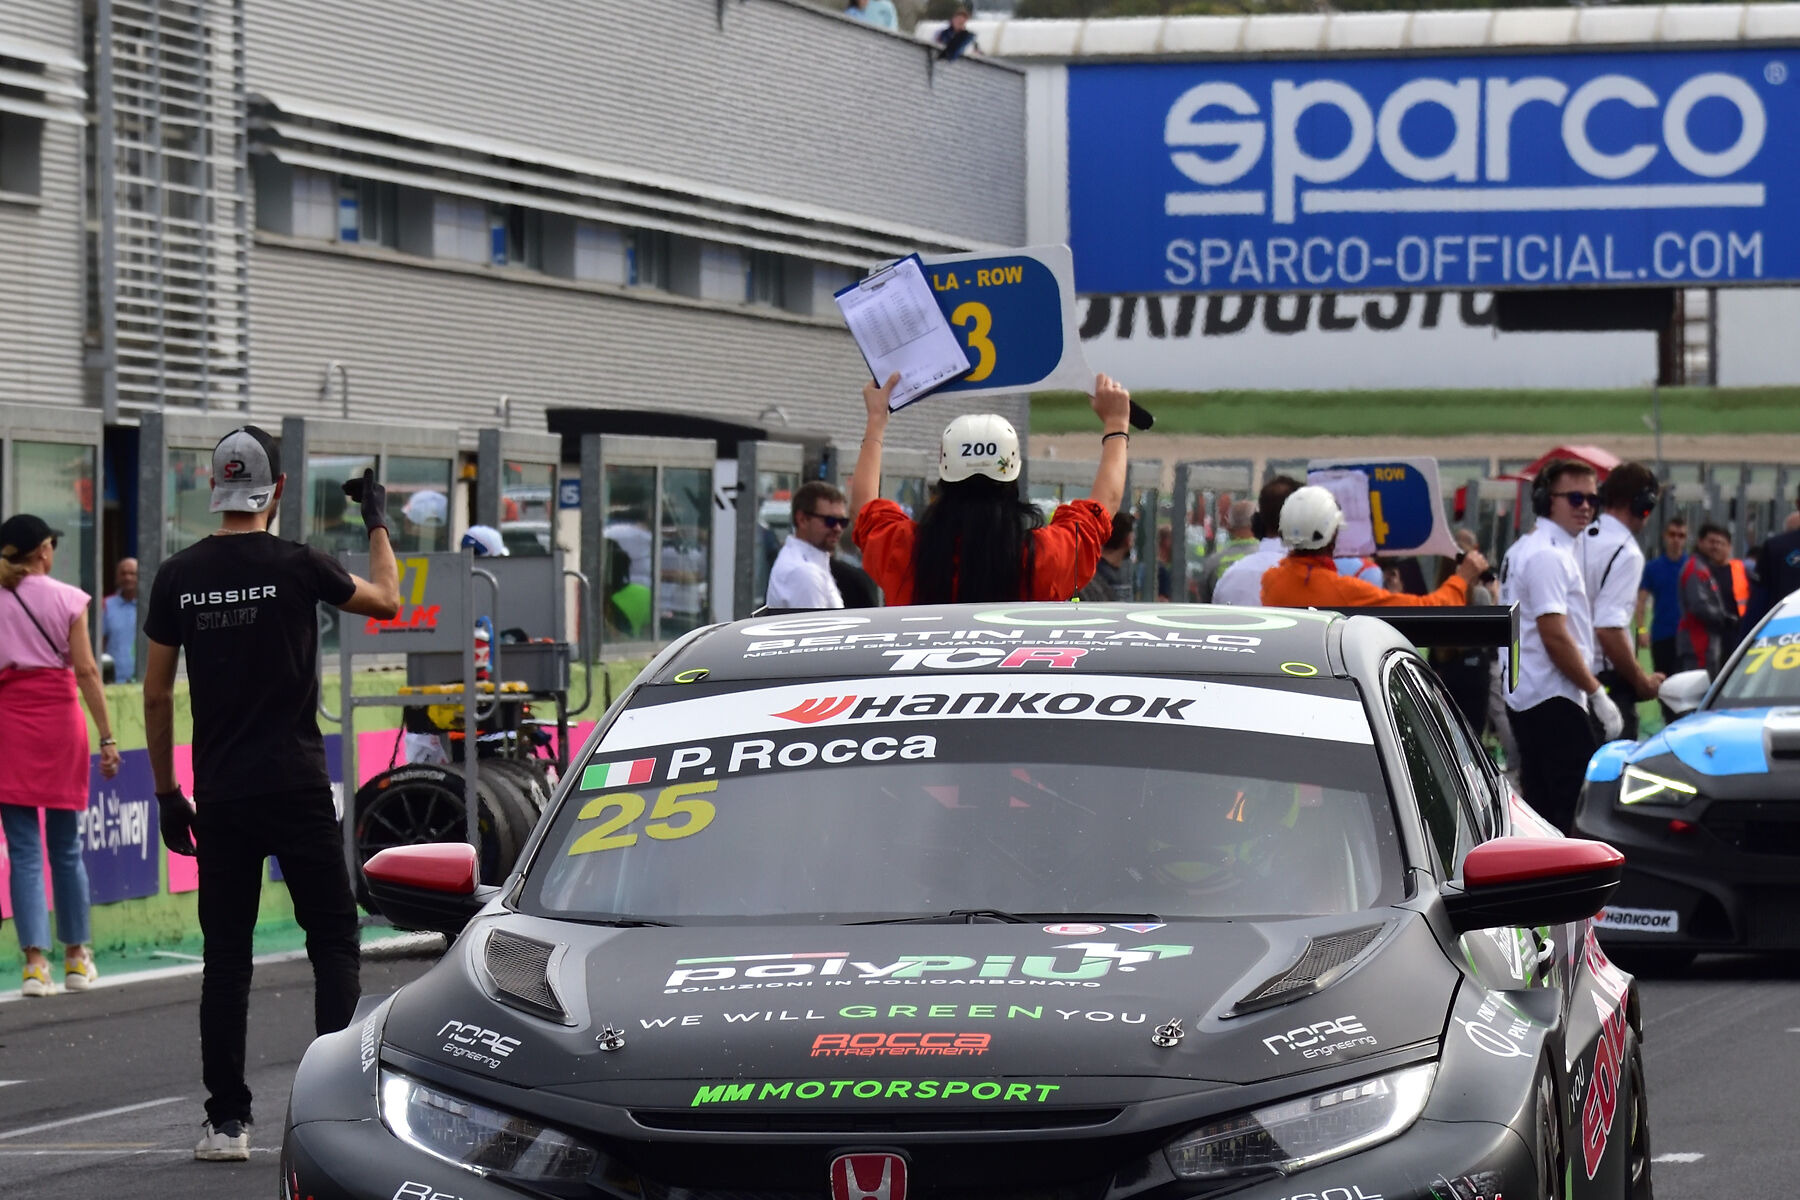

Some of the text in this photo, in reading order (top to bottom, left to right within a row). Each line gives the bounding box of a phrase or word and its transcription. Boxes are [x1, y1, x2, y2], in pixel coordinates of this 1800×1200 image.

[1164, 72, 1767, 224] sparco
[1164, 231, 1765, 287] SPARCO-OFFICIAL.COM
[976, 266, 1023, 288] ROW
[951, 301, 997, 382] 3
[961, 441, 998, 457] 200
[1374, 467, 1406, 481] ROW
[180, 585, 277, 609] PUSSIER
[196, 607, 259, 630] STAFF
[743, 645, 856, 659] NOLEGGIO
[1129, 642, 1257, 654] ELETTRICA
[747, 630, 1262, 652] BERTIN ITALO
[568, 779, 719, 856] 25
[119, 800, 149, 860] way
[664, 981, 813, 994] SOLUZIONI
[865, 979, 1101, 988] POLICARBONATO
[640, 1005, 1147, 1029] WE WILL GREEN YOU
[442, 1042, 502, 1069] Engineering
[1302, 1035, 1378, 1059] Engineering
[758, 1080, 1060, 1103] MOTORSPORT
